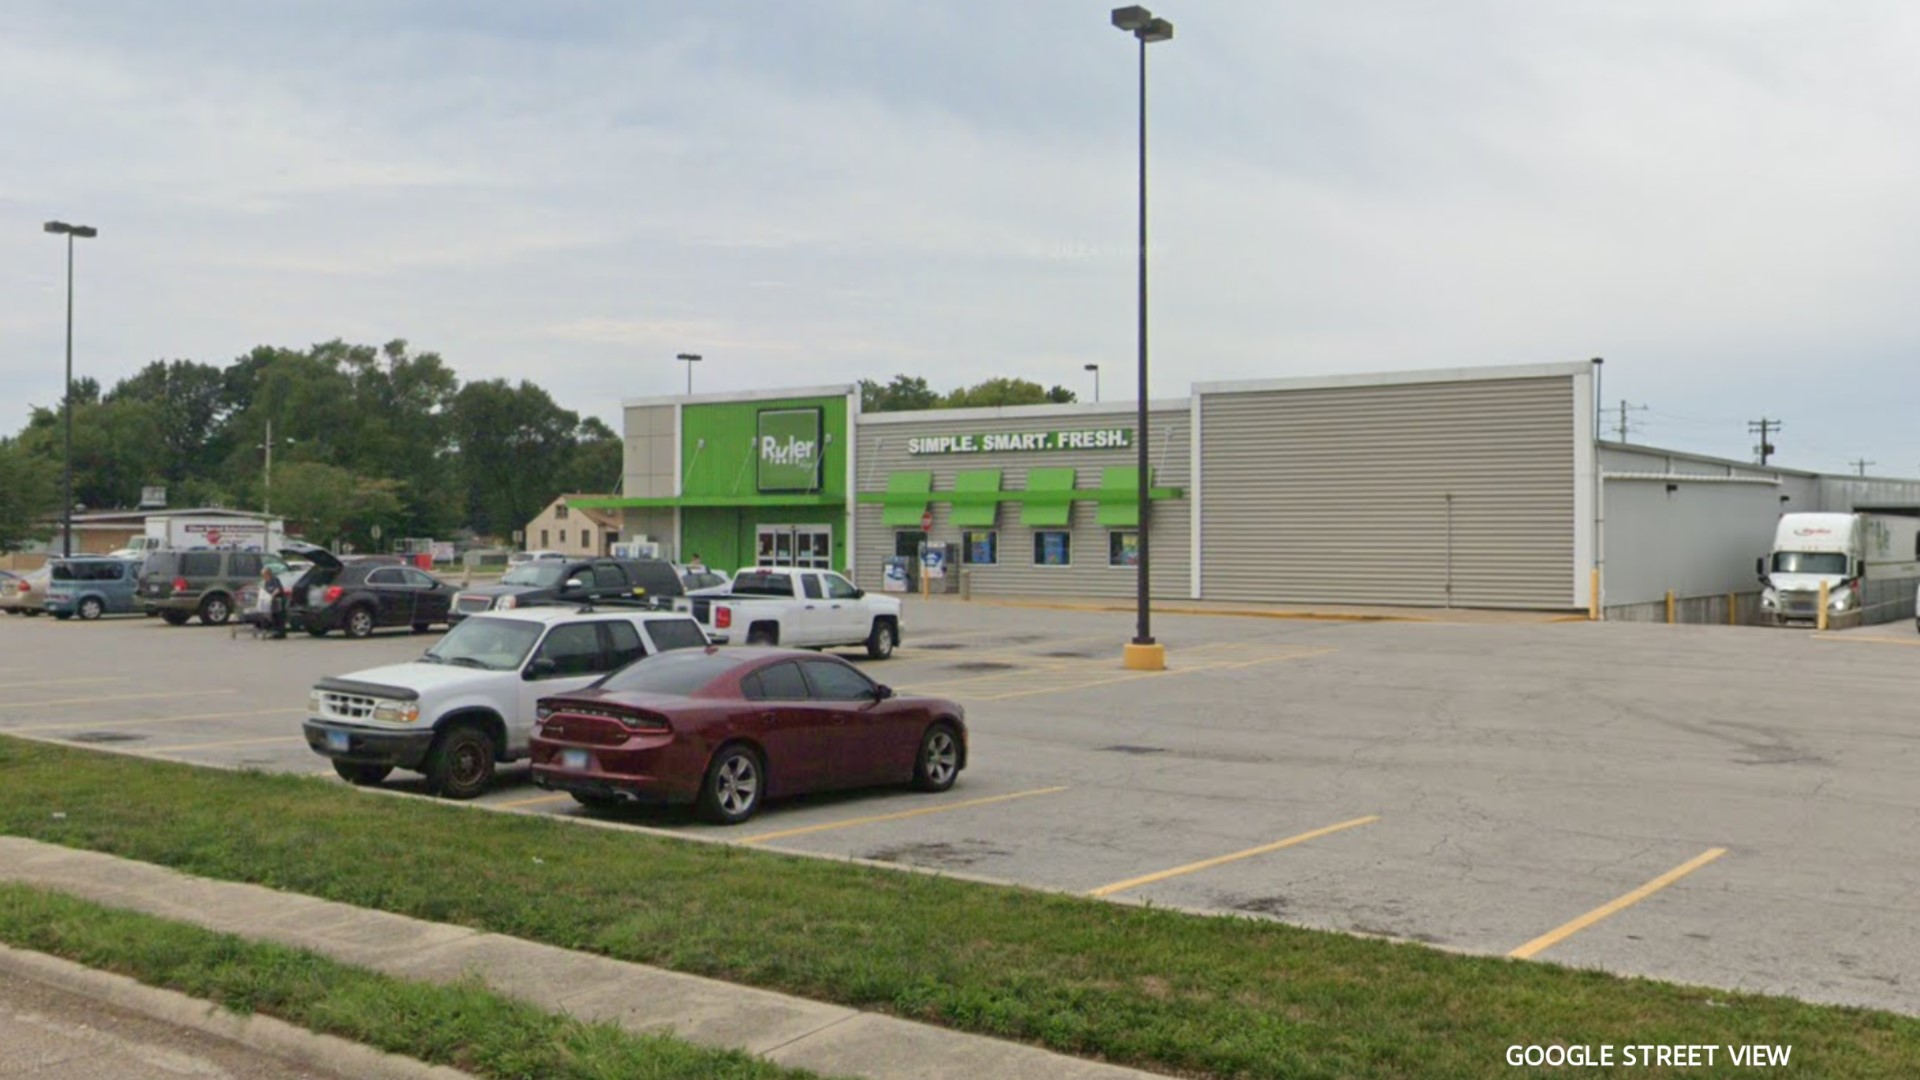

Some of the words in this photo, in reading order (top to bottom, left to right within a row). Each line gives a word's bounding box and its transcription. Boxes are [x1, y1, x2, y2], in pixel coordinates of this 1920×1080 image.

[908, 436, 978, 453] SIMPLE.
[982, 433, 1053, 450] SMART.
[1057, 430, 1128, 447] FRESH.
